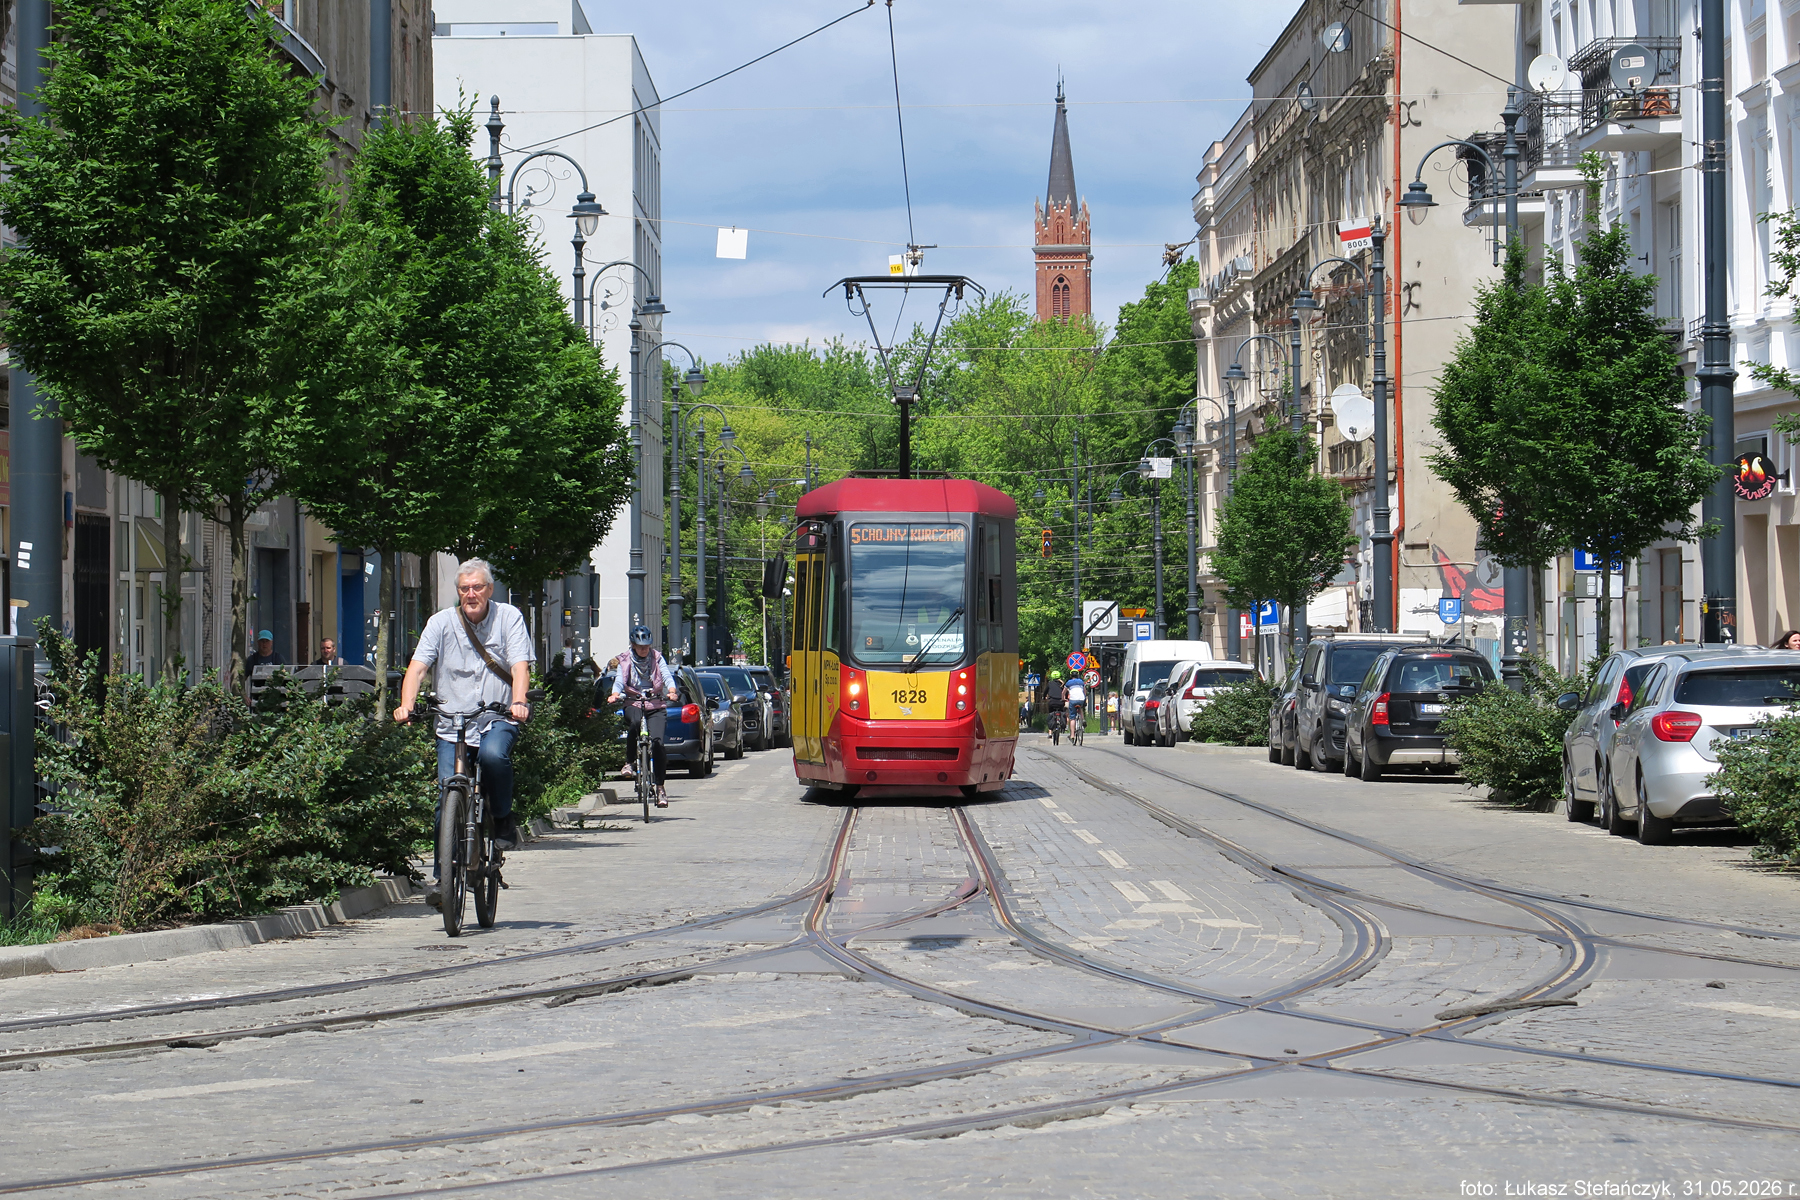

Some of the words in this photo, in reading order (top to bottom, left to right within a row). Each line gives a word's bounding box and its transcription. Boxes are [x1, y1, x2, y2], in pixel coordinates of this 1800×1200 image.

[1347, 239, 1368, 249] 8005
[851, 528, 861, 544] 5
[861, 528, 907, 542] CHOJNY
[910, 528, 964, 542] KURCZAKI
[1445, 601, 1454, 611] P
[1092, 612, 1110, 625] 30
[866, 637, 873, 646] 3
[891, 689, 927, 704] 1828
